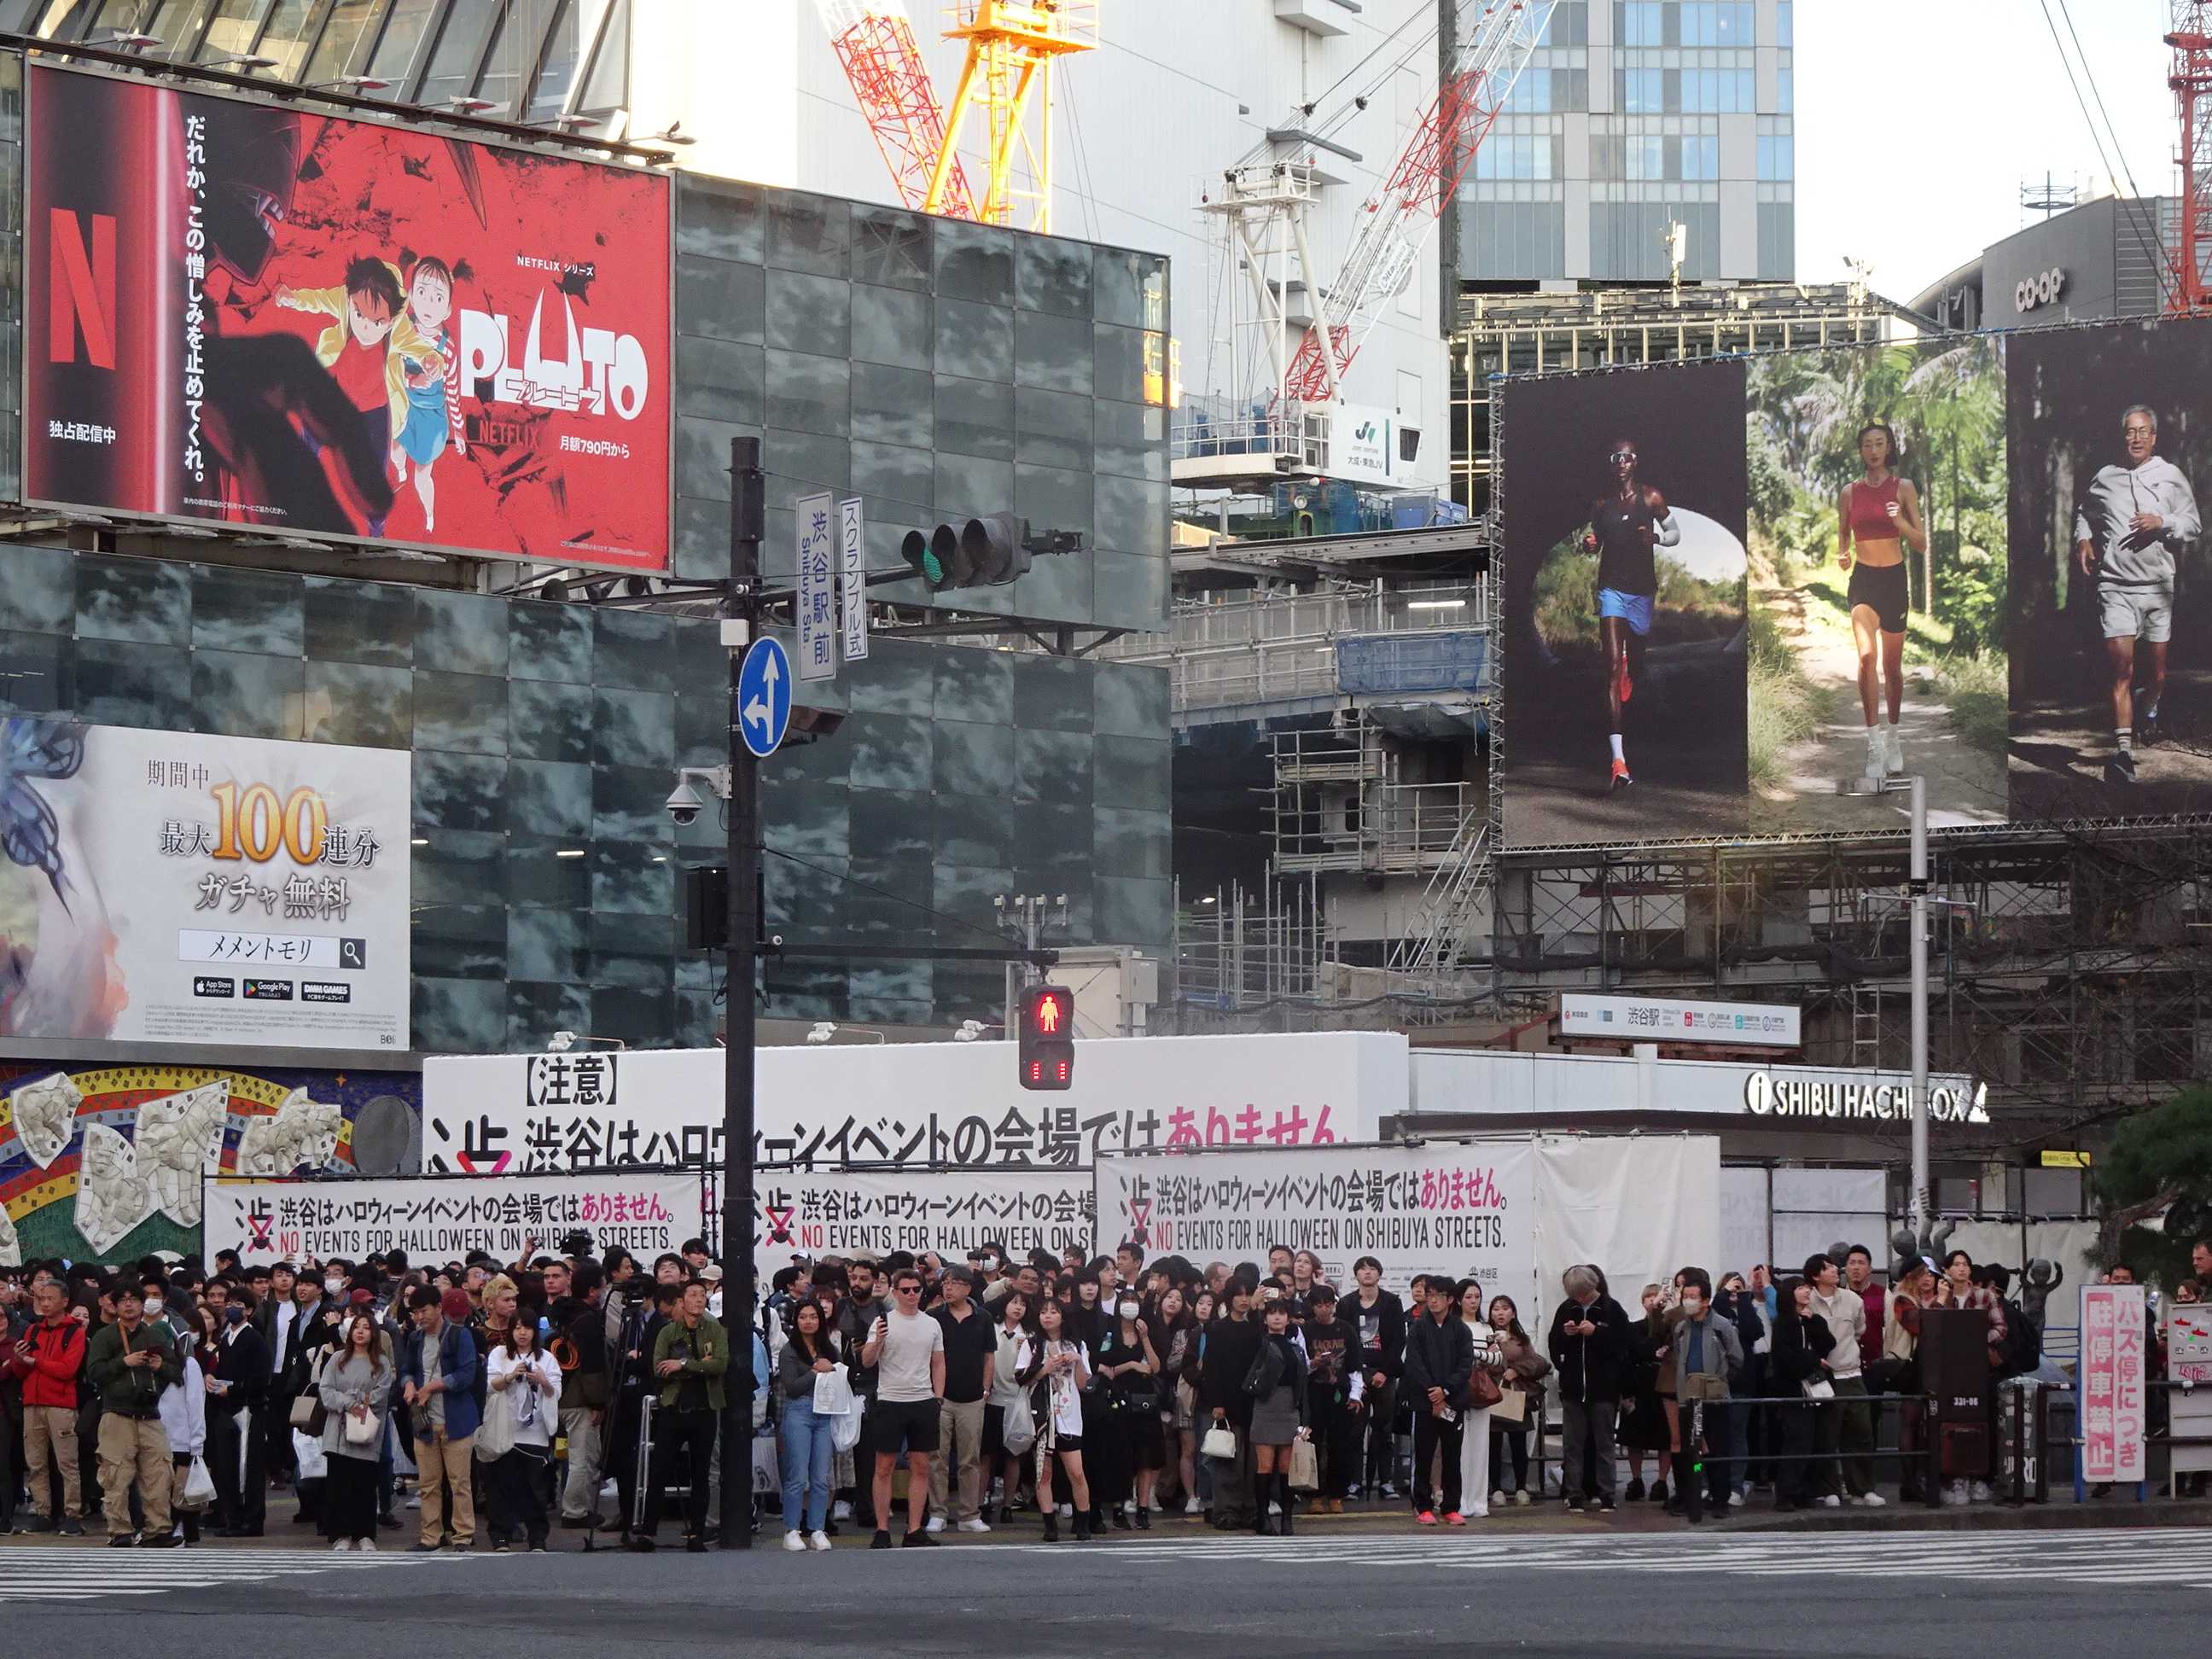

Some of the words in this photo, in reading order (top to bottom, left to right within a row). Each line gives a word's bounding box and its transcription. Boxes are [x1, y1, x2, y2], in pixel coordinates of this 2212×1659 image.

[516, 255, 561, 272] NETFLIX
[563, 263, 594, 276] シリーズ
[184, 115, 206, 483] だれか、この憎しみを止めてくれ。
[460, 286, 649, 421] PLUTO
[505, 377, 602, 410] プルートウ
[49, 419, 117, 445] 独占配信中
[560, 434, 631, 459] 月額790円から
[801, 537, 811, 608] Shibuya
[811, 509, 830, 666] 渋谷駅前
[845, 507, 863, 655] スクランブル式
[802, 614, 812, 650] Sta.
[147, 759, 210, 790] 期間中
[160, 780, 381, 867] 最大100連分
[195, 874, 351, 921] ガチャ無料
[208, 935, 312, 963] メメントモリ
[206, 981, 217, 991] App
[258, 981, 278, 992] Google
[278, 983, 291, 993] Play
[323, 985, 348, 995] GAMES
[1627, 1006, 1660, 1027] 渋谷駅
[527, 1054, 617, 1107] 【注意】
[1774, 1080, 1840, 1116] SHIBU
[280, 1191, 674, 1228] 渋谷はハロウィーンイベントの会場ではありません。
[1155, 1167, 1508, 1217] 渋谷はハロウィーンイベントの会場ではありません。
[280, 1231, 300, 1254] NO
[305, 1230, 361, 1254] EVENTS
[366, 1229, 393, 1253] FOR
[399, 1227, 495, 1253] HALLOWEEN
[500, 1227, 521, 1251] ON
[598, 1225, 674, 1251] STREETS.
[801, 1225, 824, 1249] NO
[830, 1225, 892, 1250] EVENTS
[899, 1226, 929, 1250] FOR
[937, 1225, 1044, 1251] HALLOWEEN
[1051, 1226, 1073, 1251] ON
[1156, 1220, 1173, 1251] NO
[1177, 1220, 1224, 1251] EVENTS
[1228, 1219, 1251, 1250] FOR
[1256, 1217, 1339, 1250] HALLOWEEN
[1344, 1217, 1363, 1250] ON
[1366, 1216, 1429, 1250] SHIBUYA
[1435, 1214, 1506, 1249] STREETS.
[2089, 1300, 2114, 1470] 駐停車禁止
[2116, 1301, 2139, 1469] バス停につき
